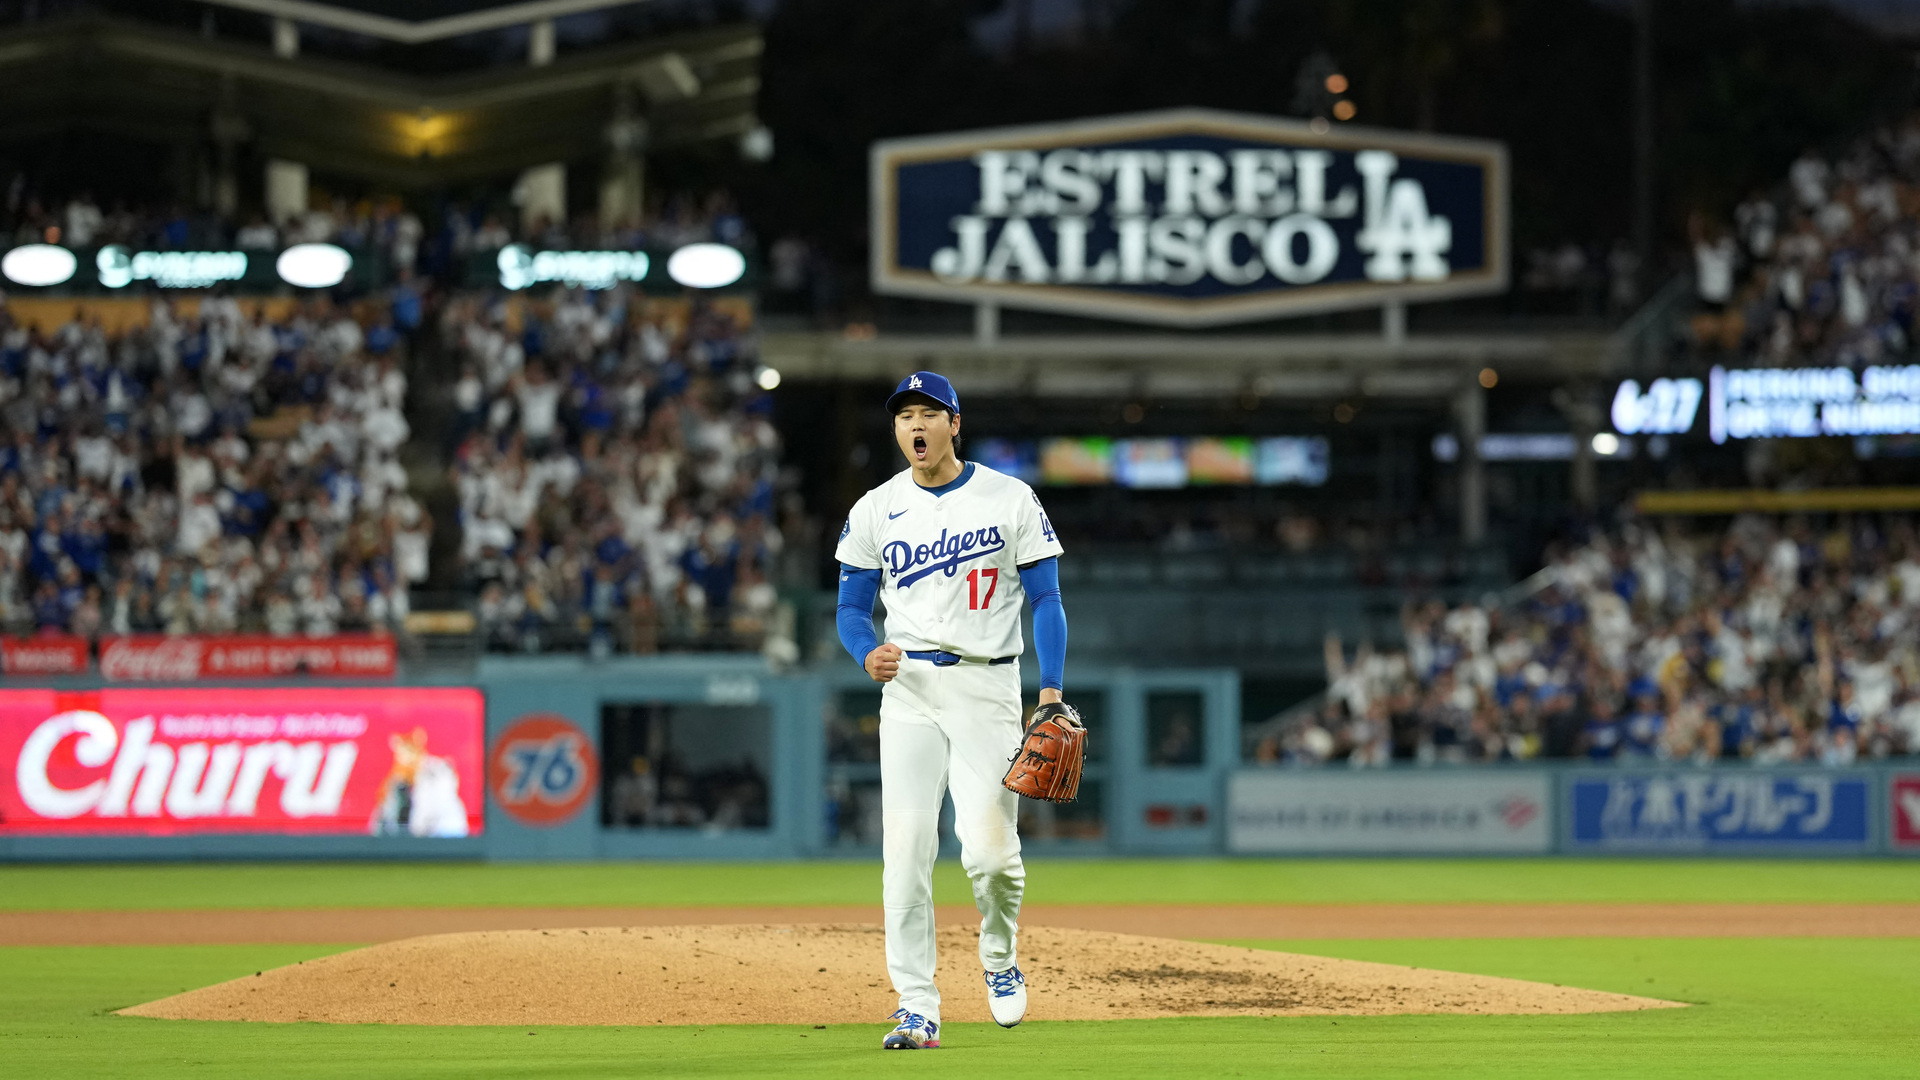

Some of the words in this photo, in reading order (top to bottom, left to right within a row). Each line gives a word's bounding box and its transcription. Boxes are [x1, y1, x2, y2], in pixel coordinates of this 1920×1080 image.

[931, 214, 1340, 285] JALISCO
[908, 374, 923, 390] LA
[882, 525, 1005, 579] Dodgers
[966, 567, 999, 611] 17
[16, 710, 360, 820] Churu
[500, 732, 588, 806] 76
